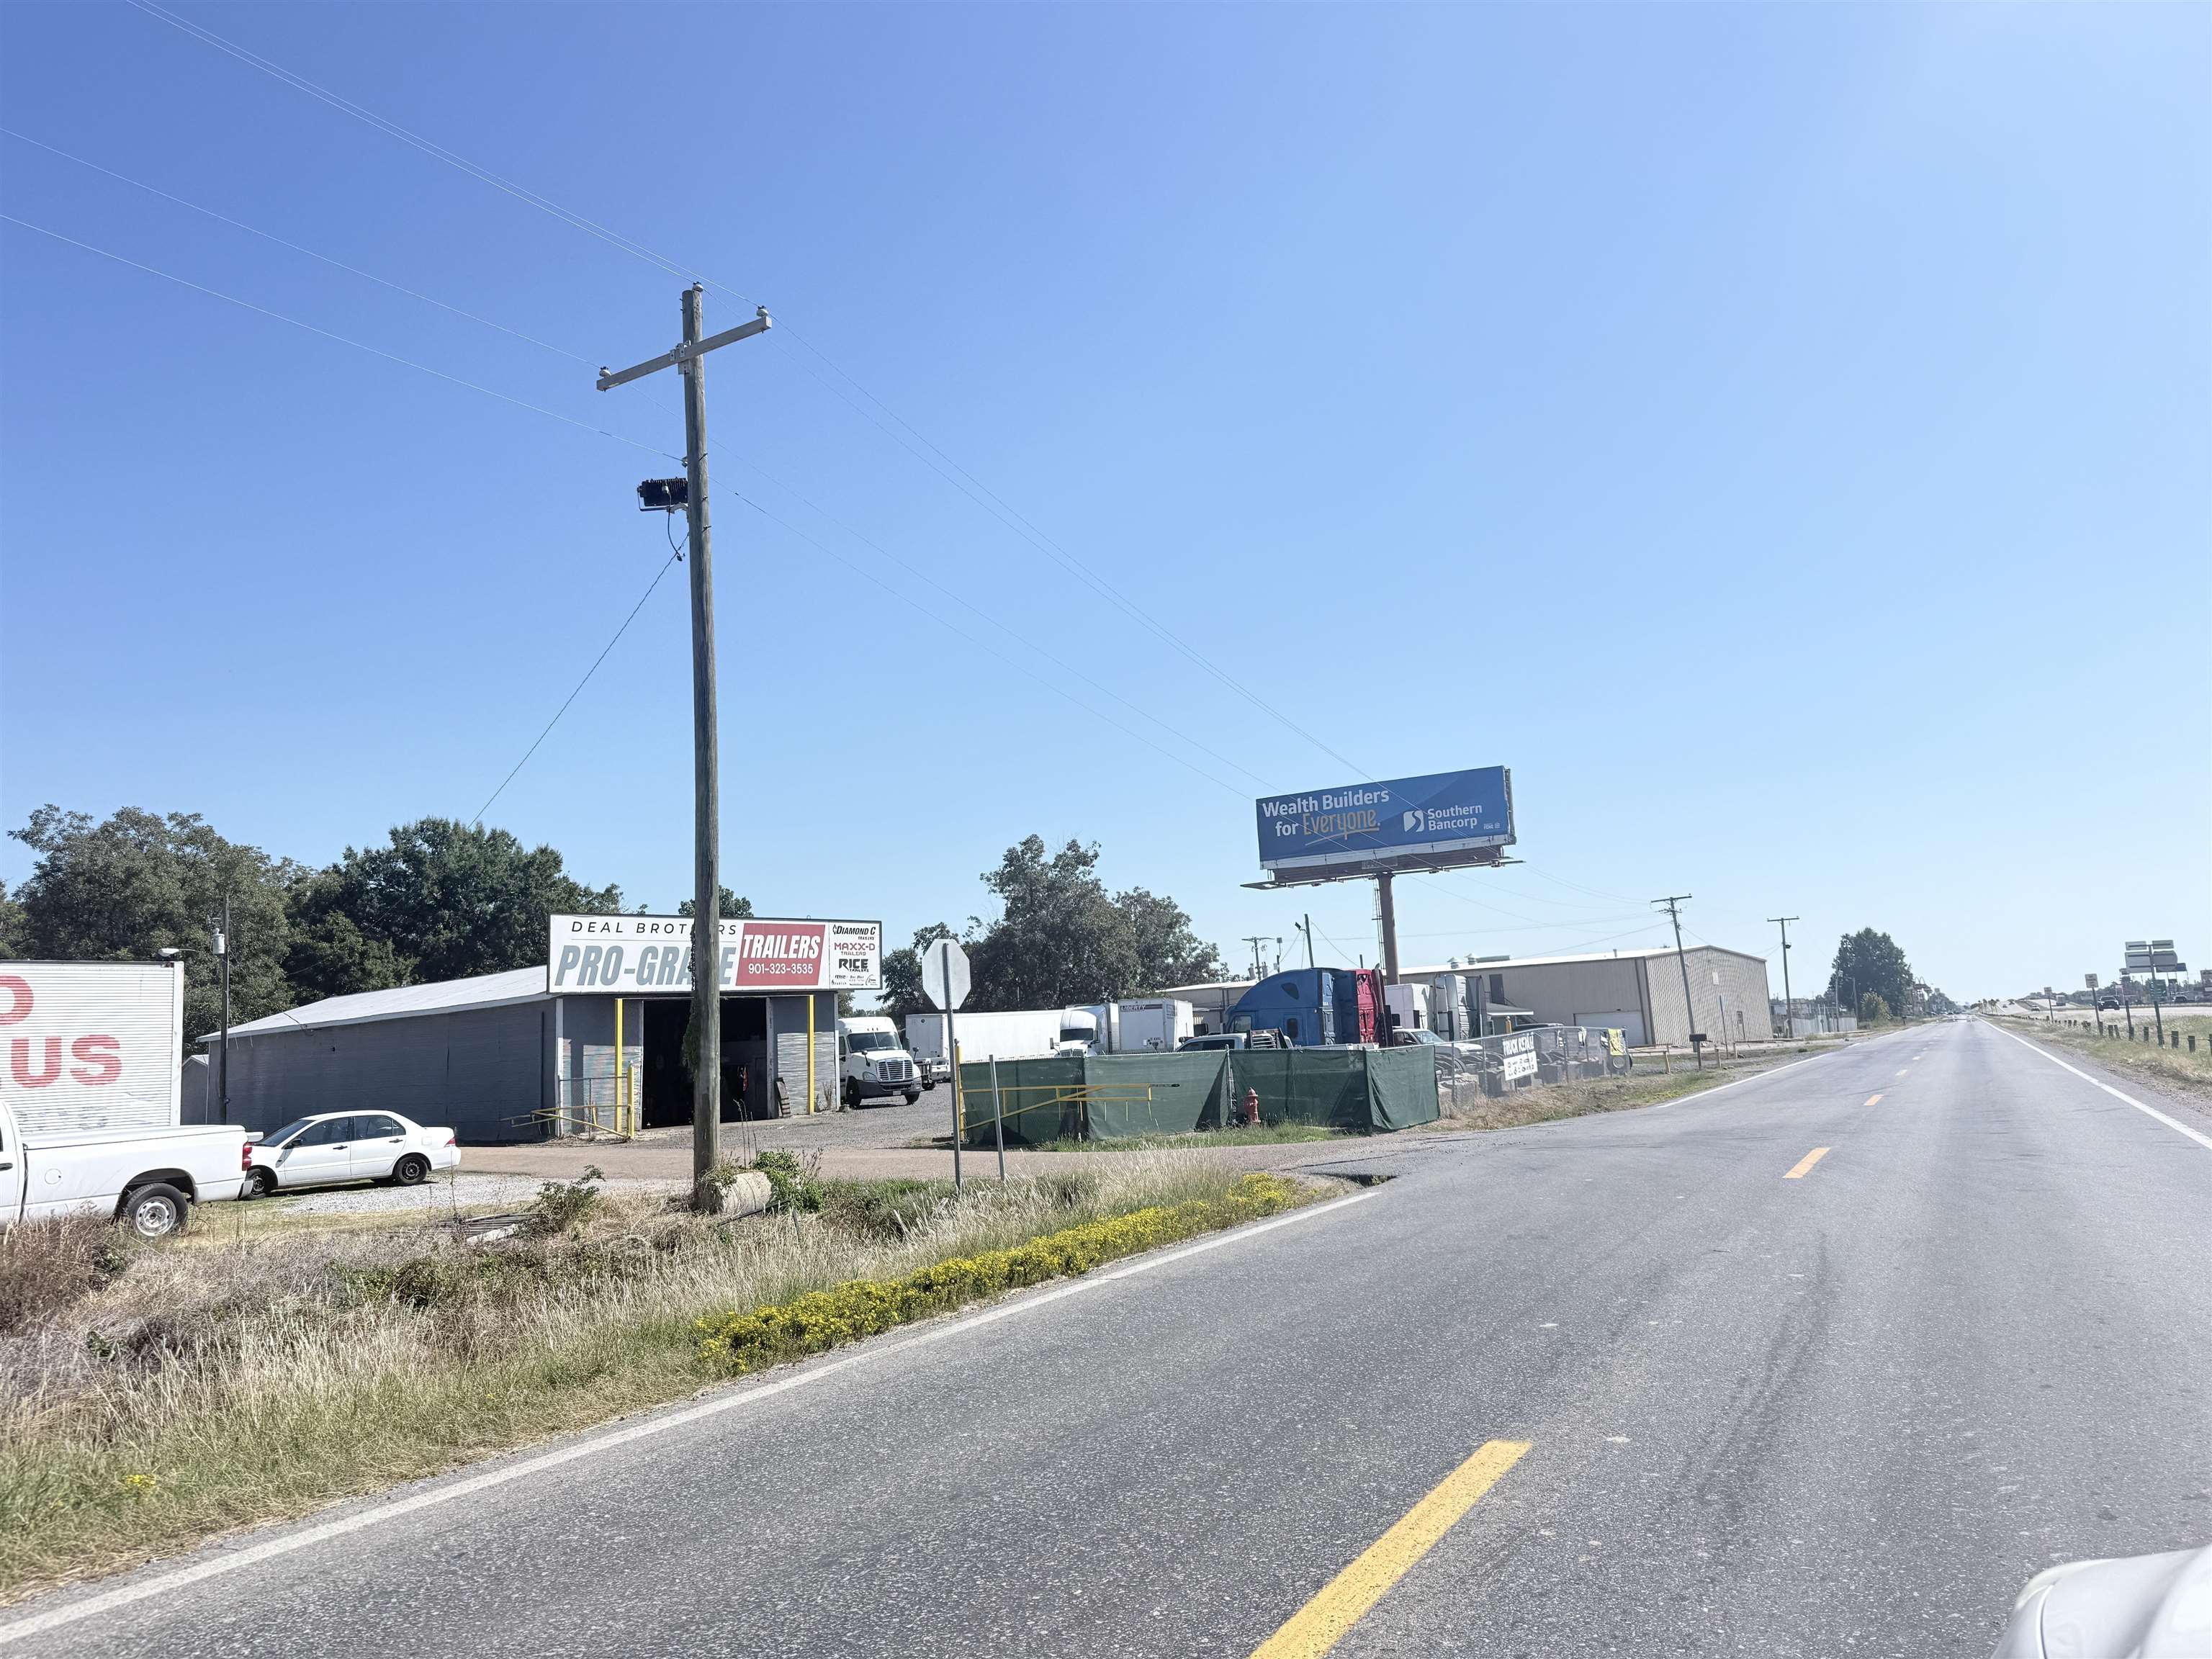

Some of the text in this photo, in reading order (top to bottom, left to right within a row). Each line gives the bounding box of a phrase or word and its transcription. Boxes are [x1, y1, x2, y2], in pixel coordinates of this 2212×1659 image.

[1262, 789, 1390, 817] Wealth Builders
[1427, 805, 1483, 819] Southern
[1275, 809, 1381, 840] for Everyone.
[1428, 817, 1478, 831] Bancorp
[572, 921, 737, 935] DEAL BROTRS
[836, 925, 876, 935] DIAMOND C
[743, 935, 821, 959] TRAILERS
[834, 942, 876, 951] MAXX-D
[554, 945, 737, 986] PRO-GRAE
[748, 963, 814, 974] 901-323-3535
[838, 958, 869, 971] RICE
